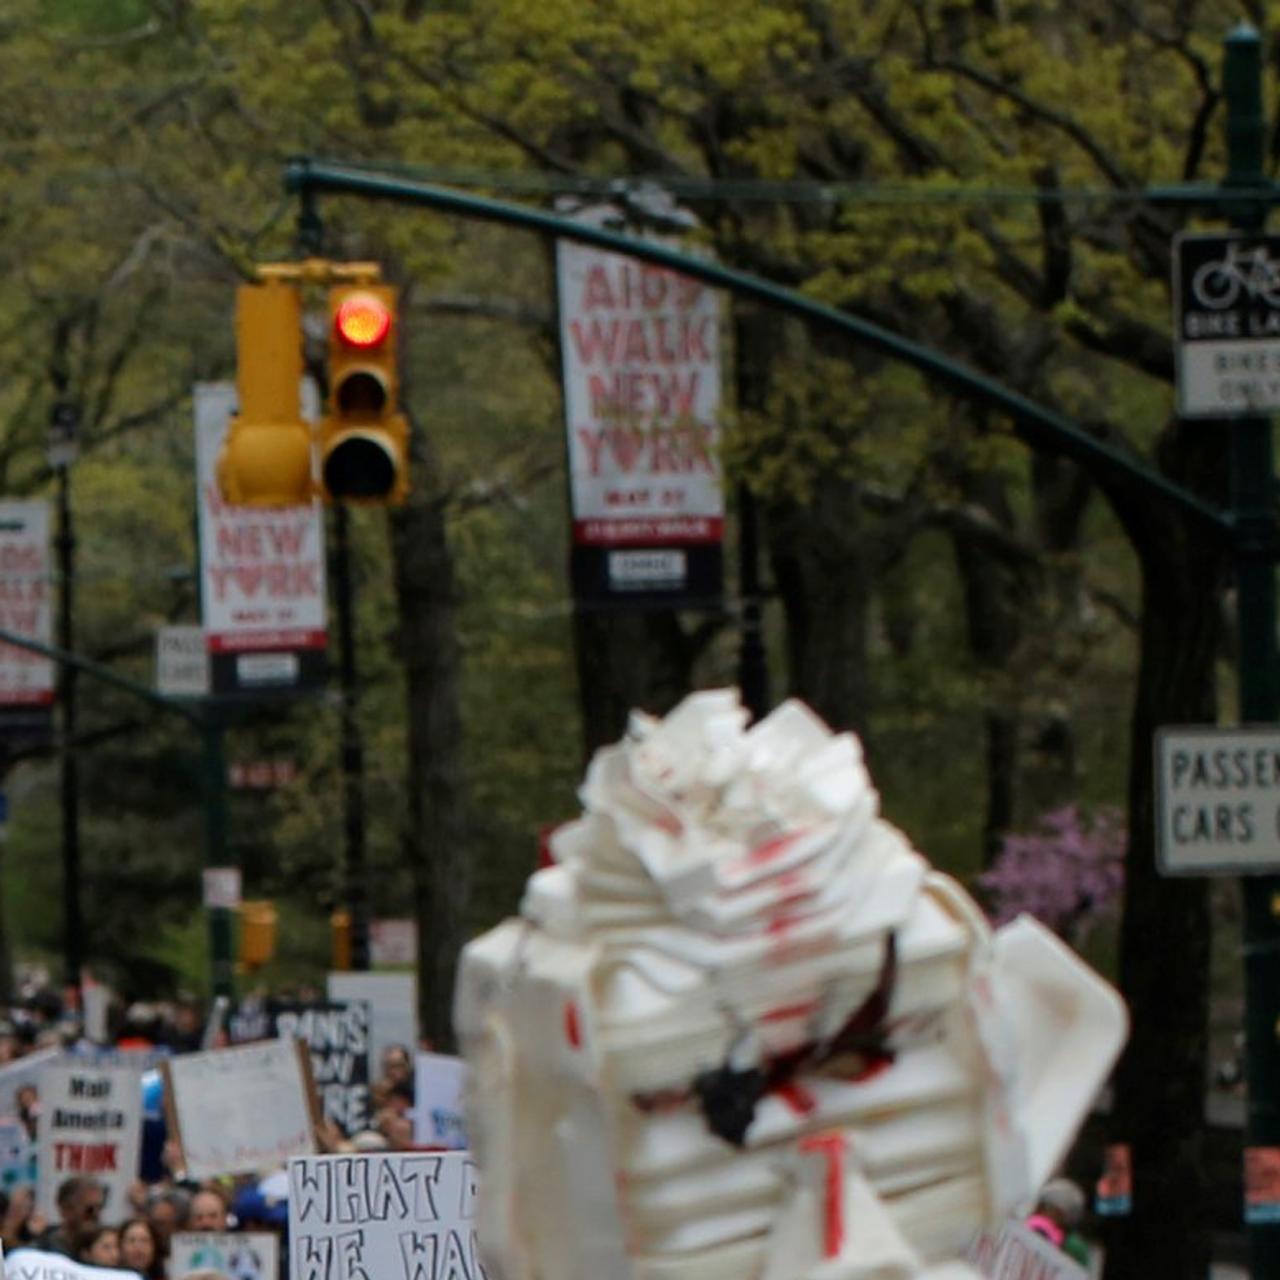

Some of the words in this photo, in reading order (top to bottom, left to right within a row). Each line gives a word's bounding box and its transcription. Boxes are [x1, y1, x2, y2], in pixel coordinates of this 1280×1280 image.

[570, 316, 710, 366] WALK
[1185, 312, 1238, 338] BIKE
[588, 369, 700, 420] NEW
[1172, 801, 1255, 844] CARS
[54, 1141, 118, 1172] THINK
[293, 1156, 441, 1225] WHAT
